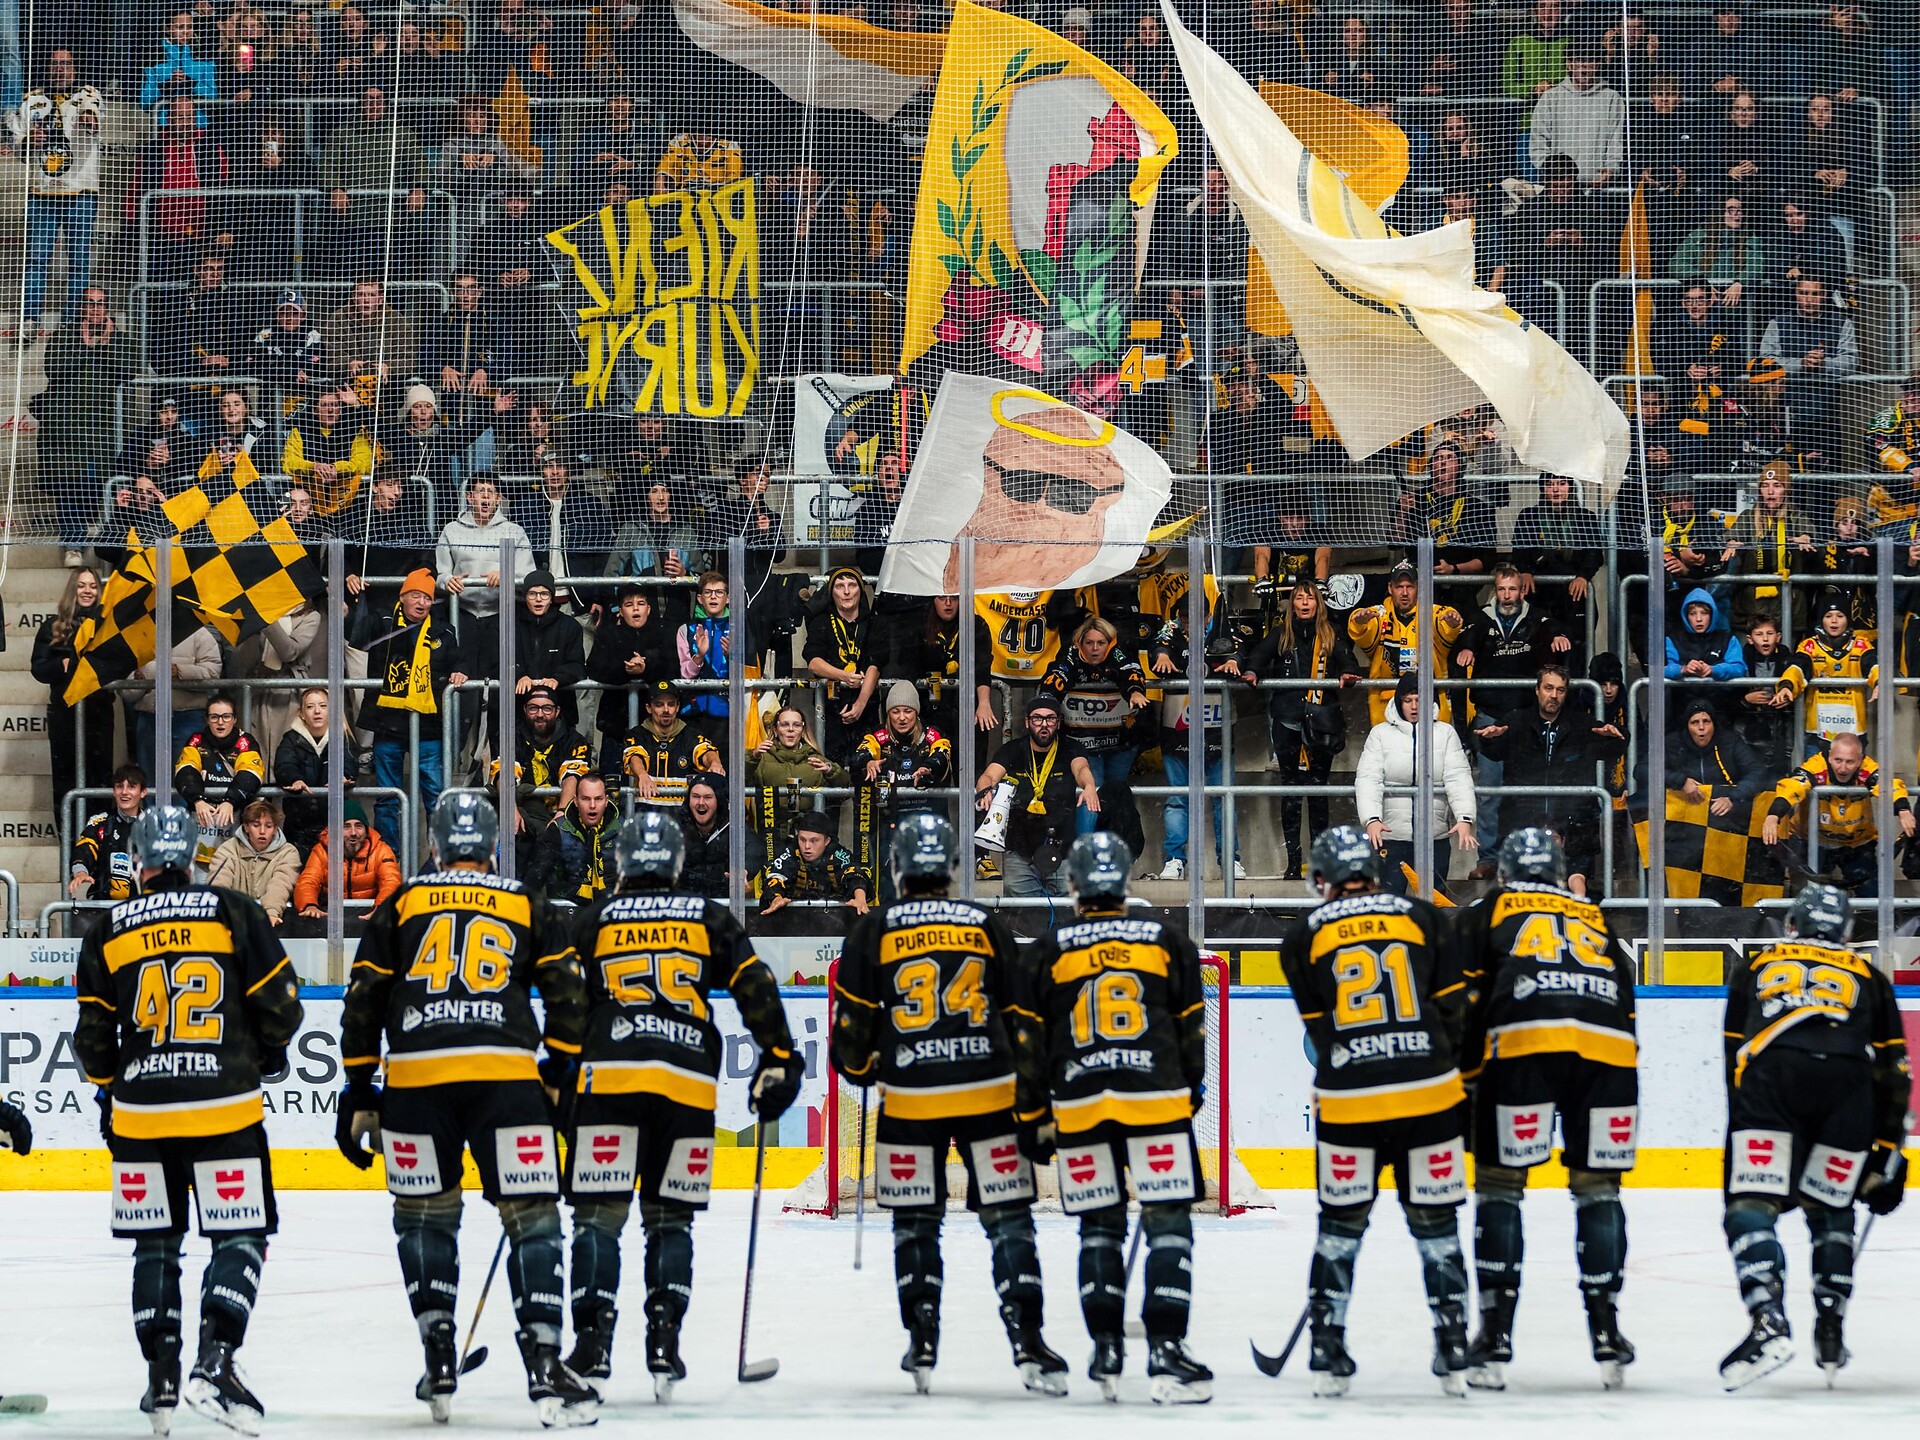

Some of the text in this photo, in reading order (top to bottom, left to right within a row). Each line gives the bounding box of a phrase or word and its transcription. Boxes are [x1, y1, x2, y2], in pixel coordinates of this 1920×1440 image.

[999, 617, 1046, 654] 40
[1066, 697, 1108, 716] engo
[429, 891, 497, 910] DELUCA
[141, 928, 192, 950] TICAR
[614, 926, 689, 946] ZANATTA
[895, 930, 984, 952] PURDELLER
[1337, 920, 1389, 939] GLIRA
[405, 913, 517, 995] 46
[601, 952, 710, 1023] 55
[891, 956, 989, 1033] 34
[1331, 942, 1421, 1031] 21
[1536, 970, 1619, 1001] SENFTER
[132, 956, 225, 1047] 42
[423, 998, 504, 1023] SENFTER
[914, 1036, 991, 1062] SENFTER
[1349, 1031, 1431, 1059] SENFTER
[140, 1051, 218, 1077] SENFTER
